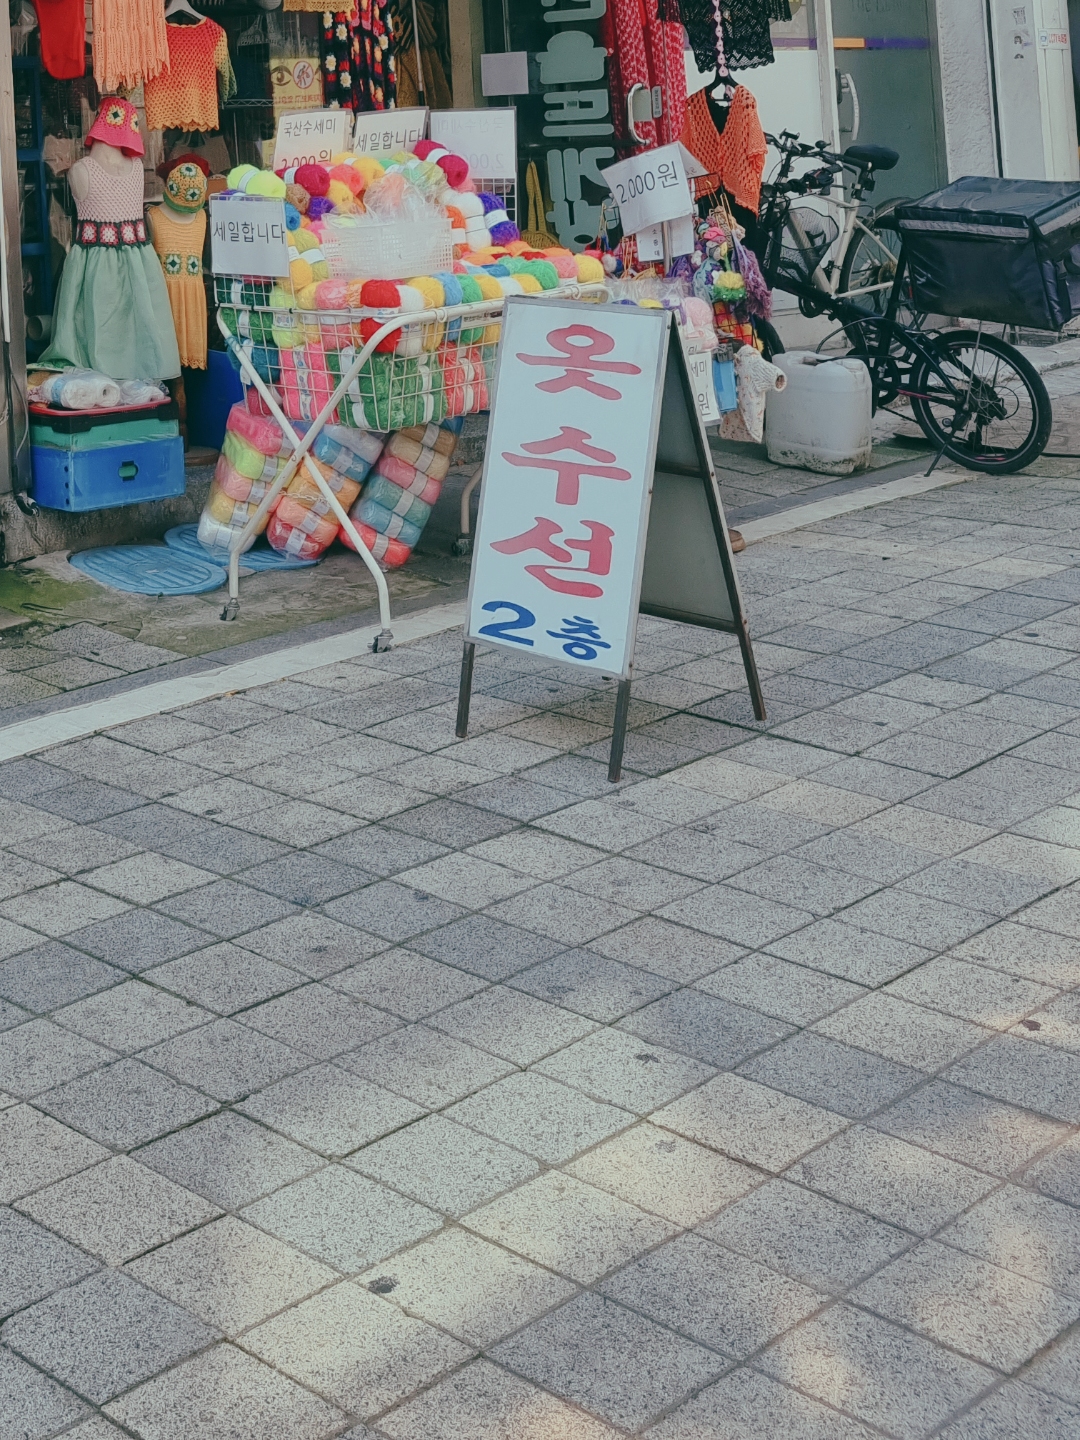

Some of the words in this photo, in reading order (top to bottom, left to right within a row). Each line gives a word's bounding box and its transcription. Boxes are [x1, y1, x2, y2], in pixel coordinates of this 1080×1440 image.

[283, 118, 336, 137] 국산수세미
[354, 128, 422, 153] 세일합니다
[616, 160, 680, 204] 2,000원
[213, 221, 286, 244] 세일합니다
[490, 324, 642, 598] 옷수선
[478, 600, 611, 661] 2층
